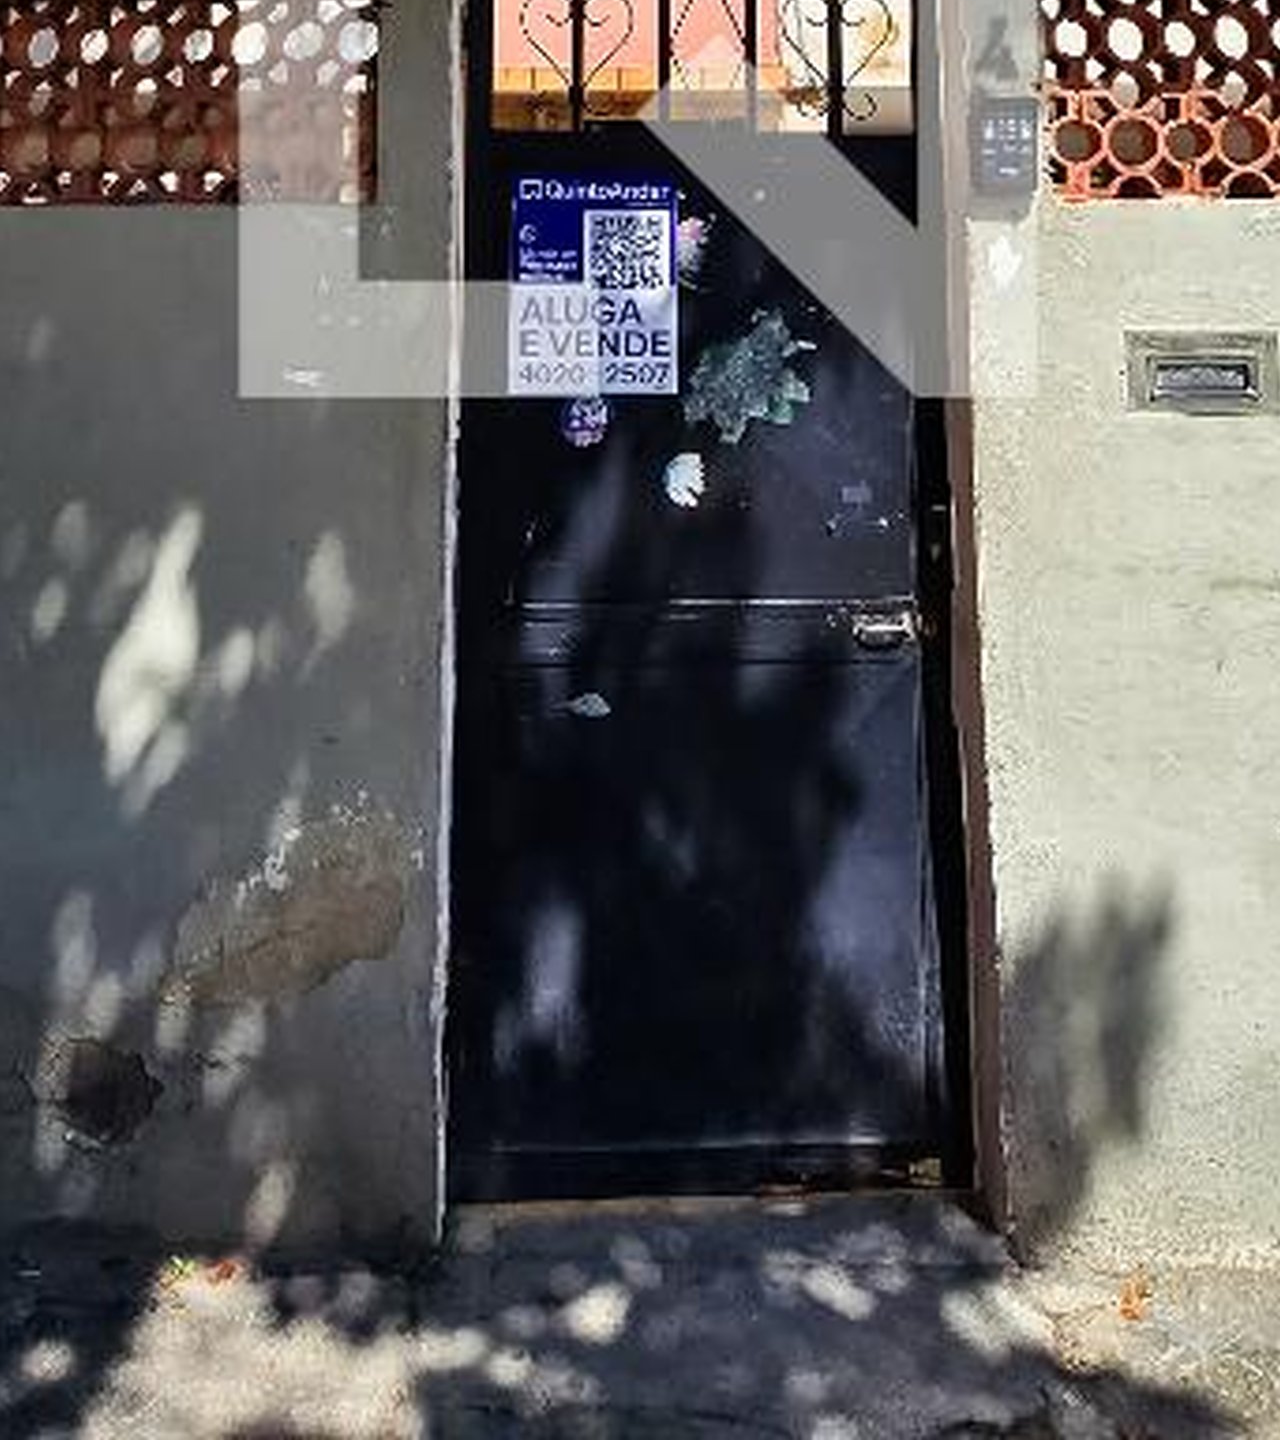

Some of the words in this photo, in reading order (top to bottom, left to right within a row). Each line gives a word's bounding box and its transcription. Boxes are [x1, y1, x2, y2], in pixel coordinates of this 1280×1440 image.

[520, 296, 643, 325] ALUGA
[520, 330, 540, 357] E
[548, 330, 671, 357] VENDE
[519, 362, 586, 383] 4020
[605, 362, 671, 384] 2507
